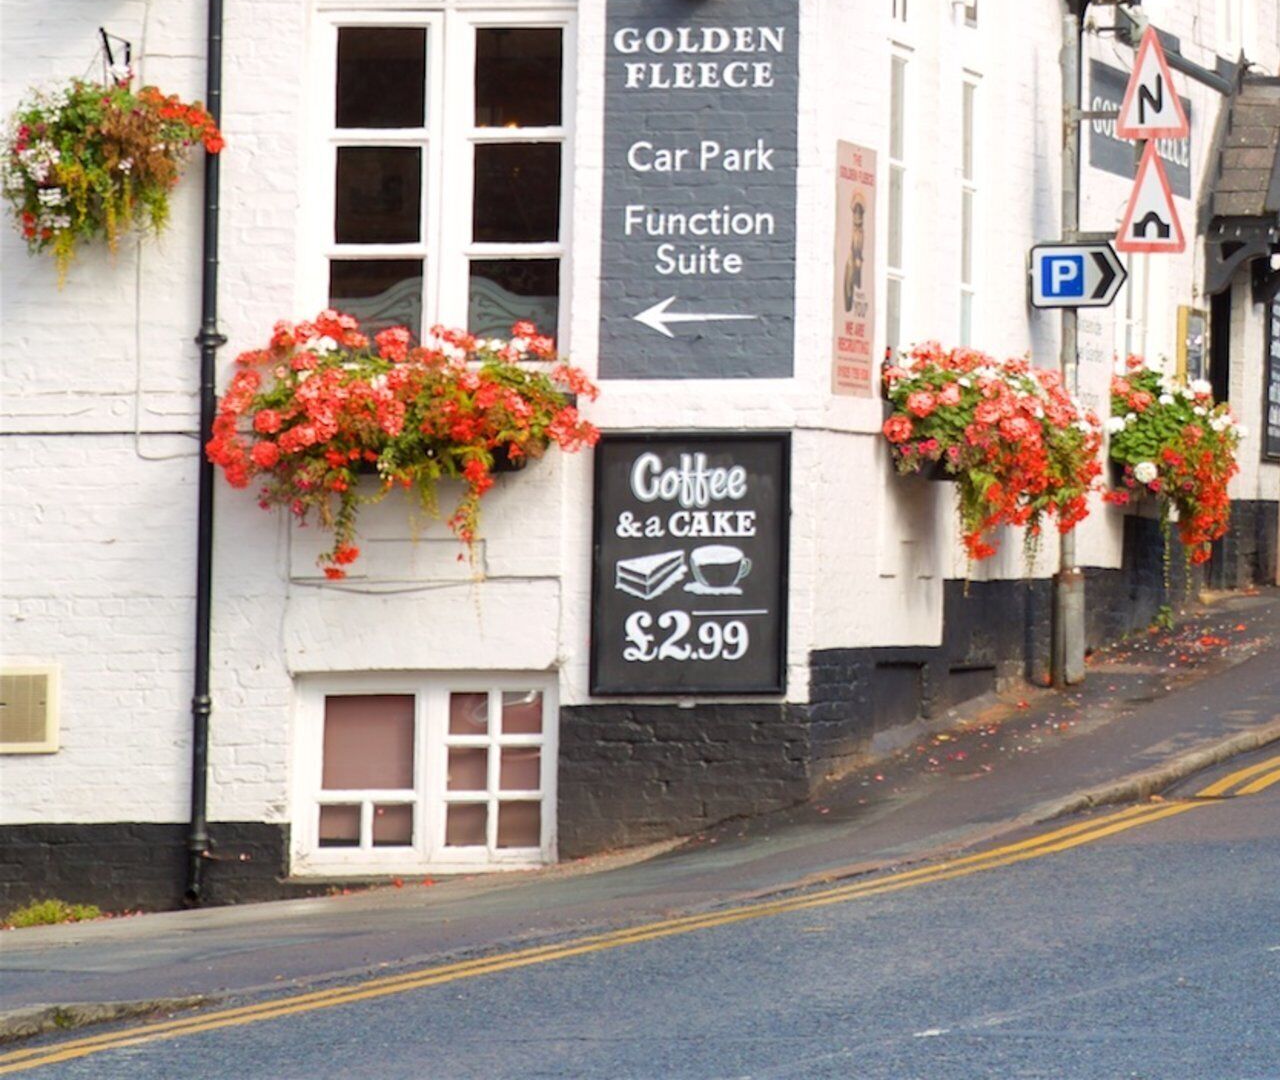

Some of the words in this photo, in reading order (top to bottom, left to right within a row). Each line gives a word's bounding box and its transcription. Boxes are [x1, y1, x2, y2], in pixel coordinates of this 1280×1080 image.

[613, 26, 785, 54] GOLDEN
[624, 61, 775, 89] FLEECE
[627, 141, 689, 172] Car
[700, 139, 775, 172] Park
[624, 204, 775, 236] Function
[655, 243, 743, 275] Suite
[1051, 261, 1078, 294] P
[631, 452, 747, 508] Coffee
[668, 510, 757, 538] CAKE
[623, 610, 750, 662] £2.99
